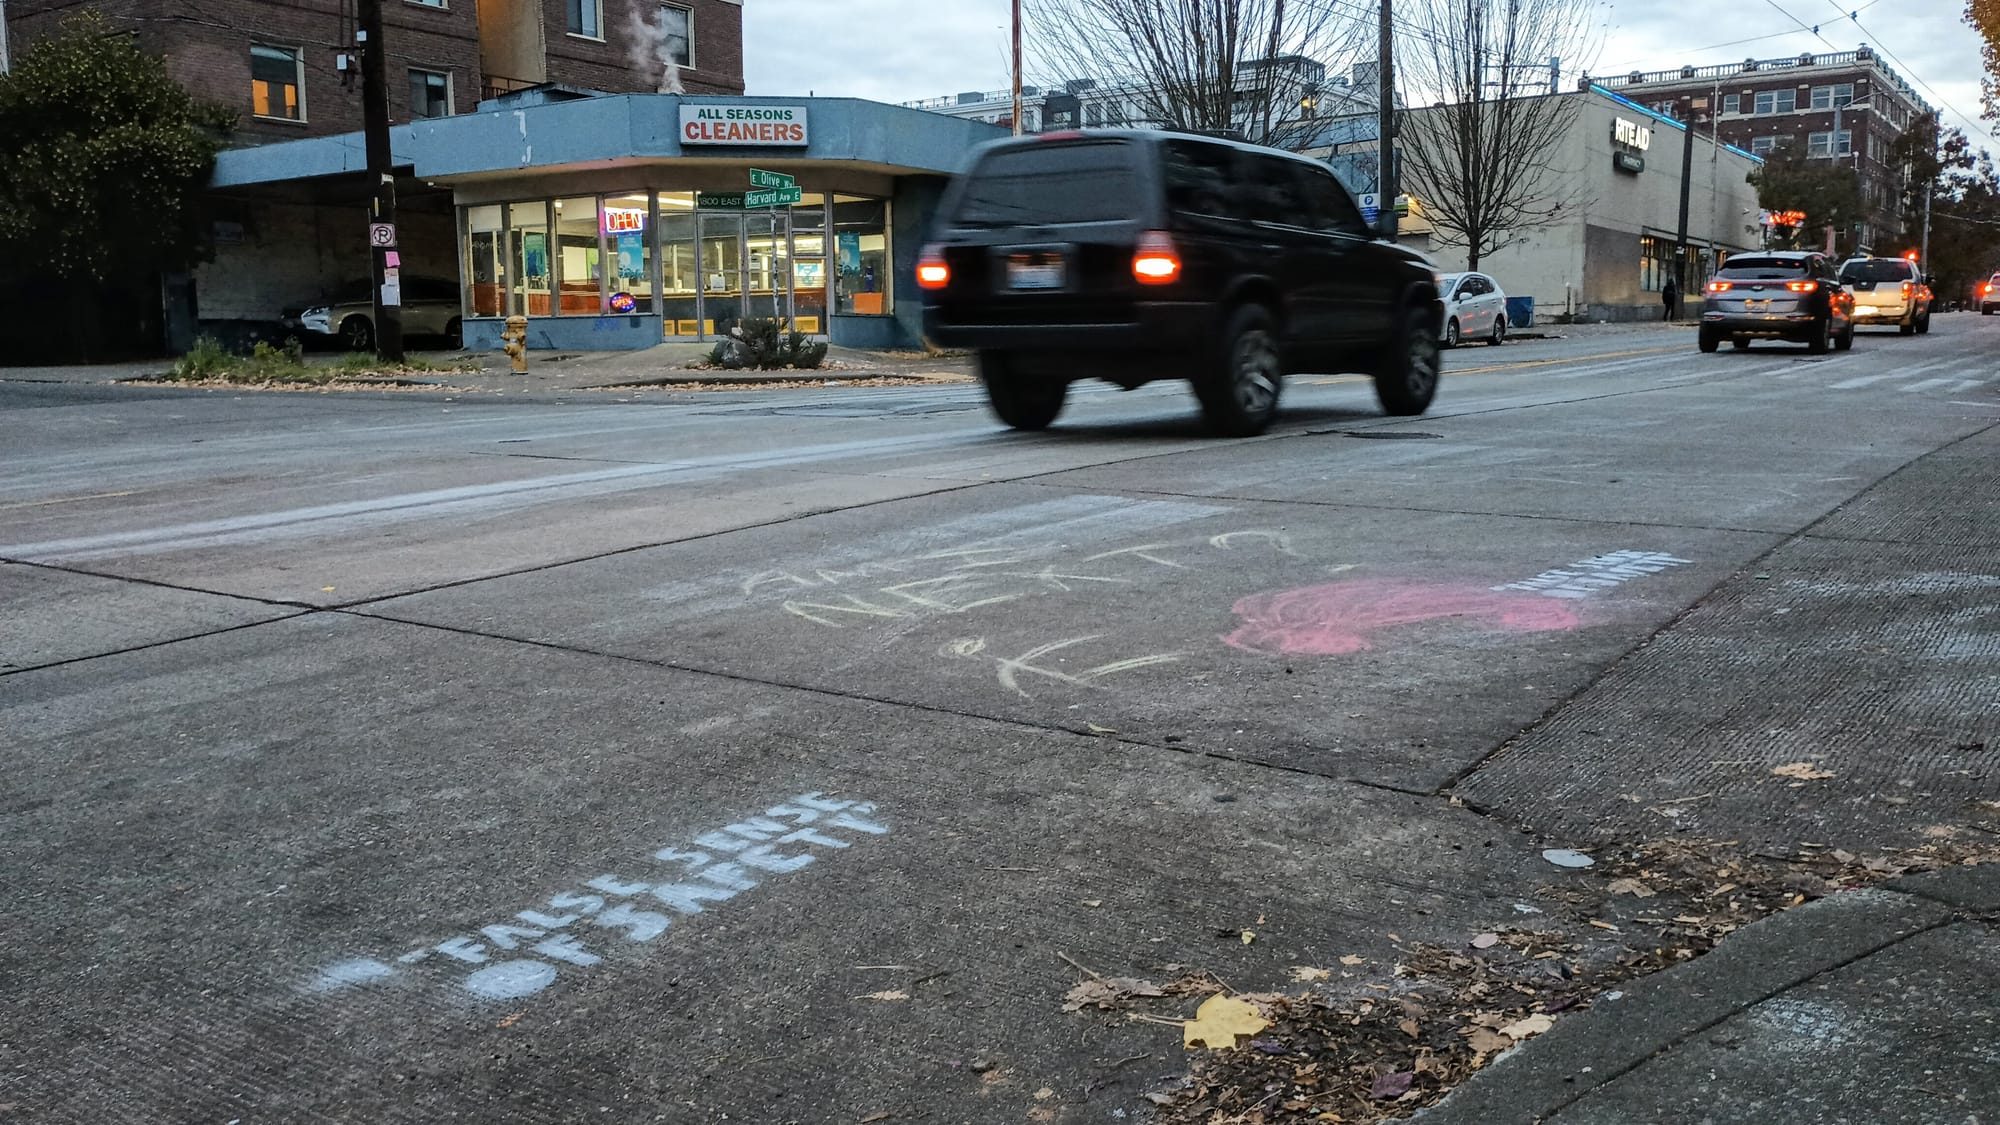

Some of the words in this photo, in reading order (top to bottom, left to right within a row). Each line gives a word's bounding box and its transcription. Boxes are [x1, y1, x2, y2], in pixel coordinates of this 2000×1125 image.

[698, 109, 723, 119] ALL
[726, 109, 793, 120] SEASONS
[685, 121, 804, 141] CLEANERS
[1615, 116, 1635, 146] RITE
[1634, 125, 1650, 151] AID
[752, 174, 757, 183] E
[761, 172, 780, 187] Olive
[721, 198, 741, 206] EAST
[747, 191, 777, 206] Harvard
[779, 193, 791, 202] Ave
[794, 191, 800, 200] E
[608, 211, 640, 231] OPEN
[614, 296, 634, 308] OPEN
